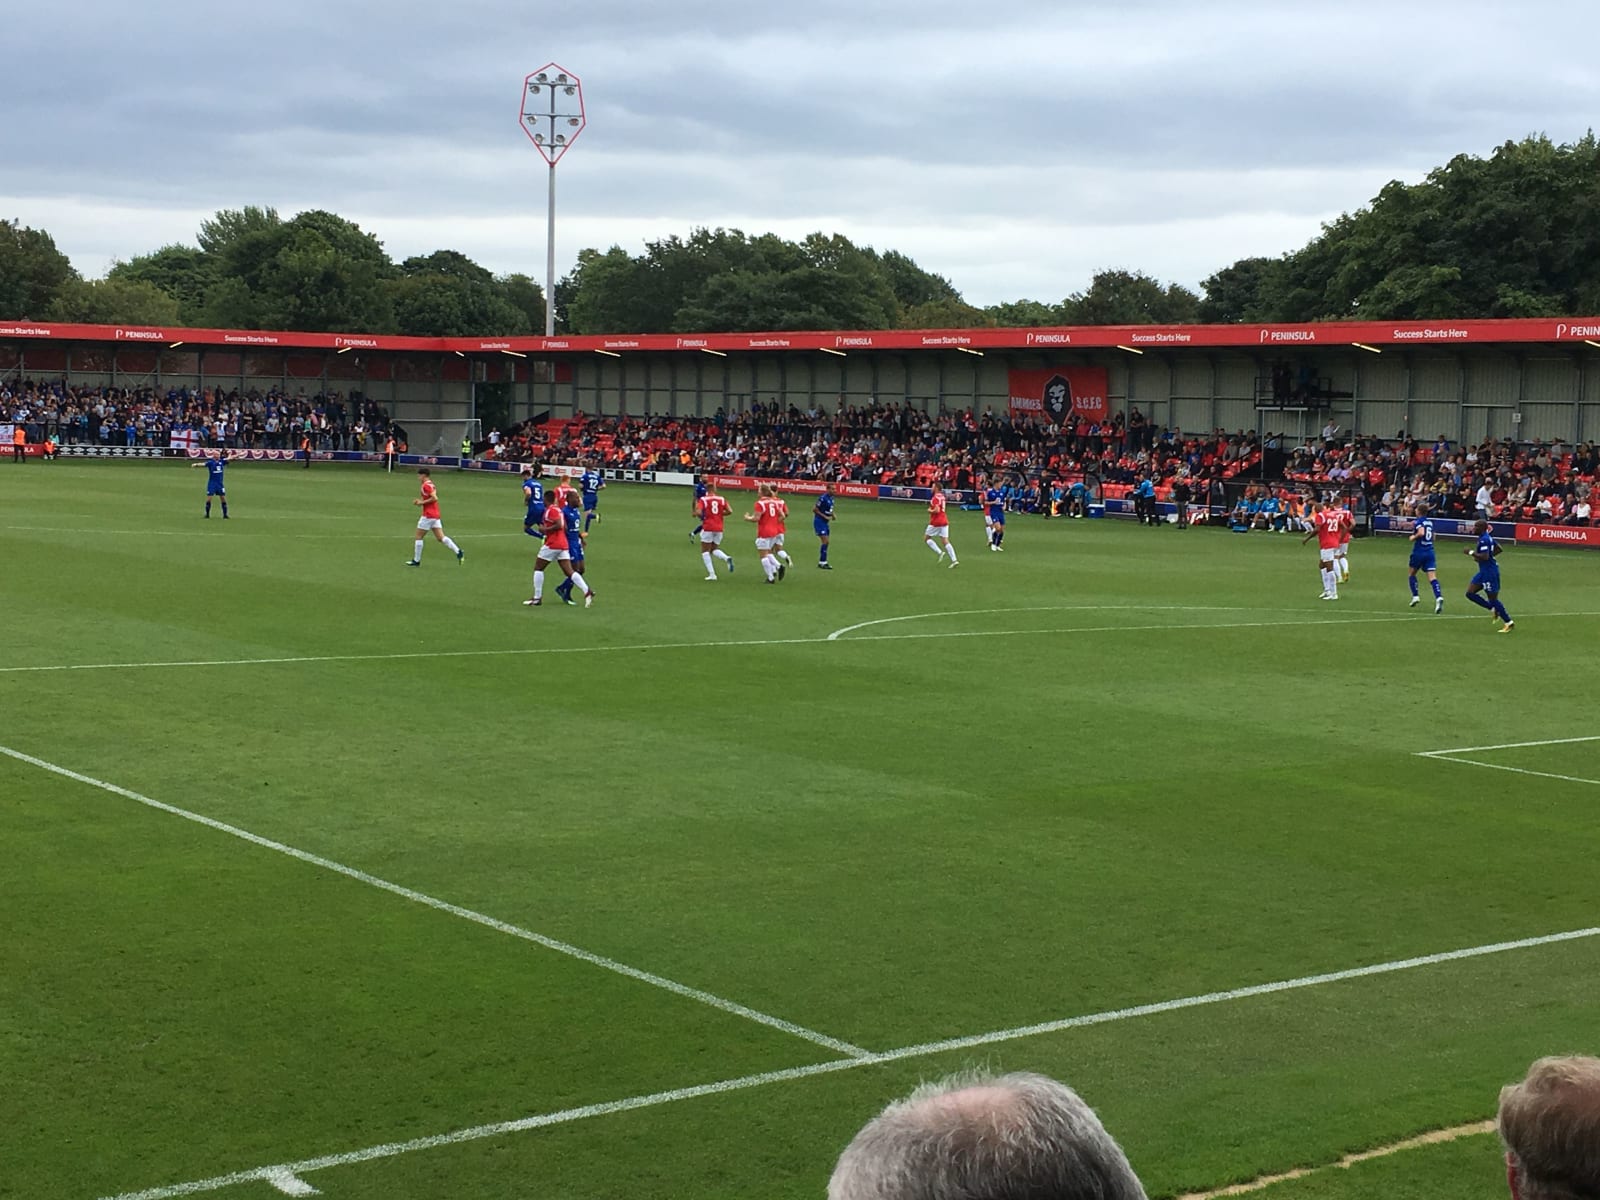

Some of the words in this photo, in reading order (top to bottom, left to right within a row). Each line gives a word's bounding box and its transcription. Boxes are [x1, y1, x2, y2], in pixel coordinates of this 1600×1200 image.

[125, 331, 163, 339] PENINSULA
[1035, 334, 1071, 343] PENINSULA
[1131, 333, 1156, 342] Success
[1156, 333, 1174, 342] Starts
[1175, 333, 1191, 341] Here
[1271, 331, 1315, 341] PENINSULA
[1393, 329, 1423, 339] Success
[1424, 329, 1448, 338] Starts
[1448, 329, 1468, 338] Here
[588, 479, 599, 490] 12
[534, 487, 541, 499] 5
[711, 500, 719, 514] 8
[769, 503, 776, 517] 6
[1327, 518, 1338, 532] 23
[1425, 527, 1432, 541] 6
[1540, 529, 1587, 540] PENINSULA
